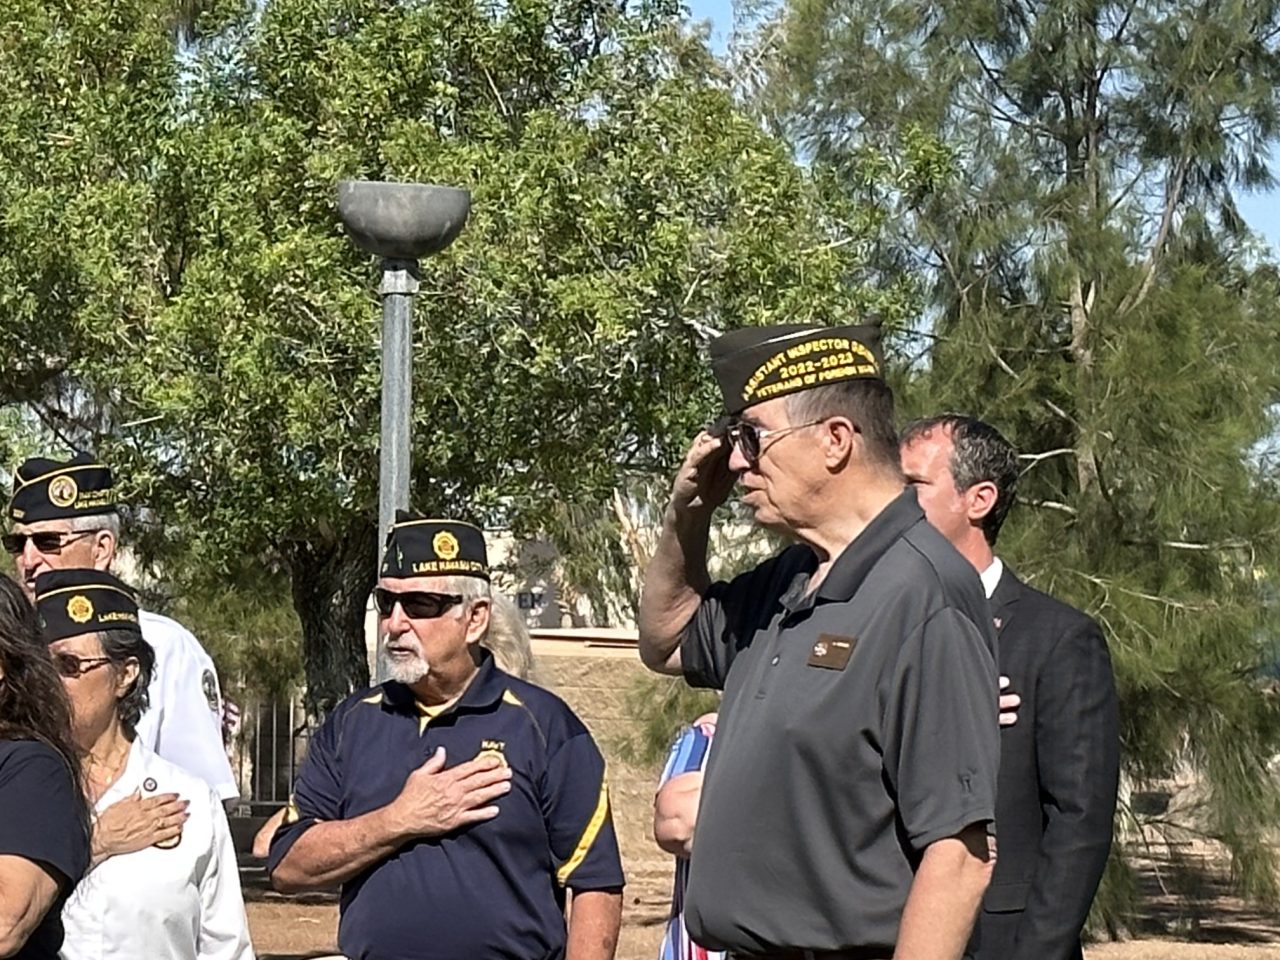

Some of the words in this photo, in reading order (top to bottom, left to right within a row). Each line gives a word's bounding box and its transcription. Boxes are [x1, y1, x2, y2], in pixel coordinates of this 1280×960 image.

[787, 339, 850, 358] INSPECTOR
[779, 352, 854, 379] 2022-2023
[755, 376, 803, 398] VETERANS
[804, 374, 817, 384] OF
[819, 365, 857, 382] FOREIGN
[412, 561, 437, 573] LAKE
[481, 740, 506, 750] NAVY
